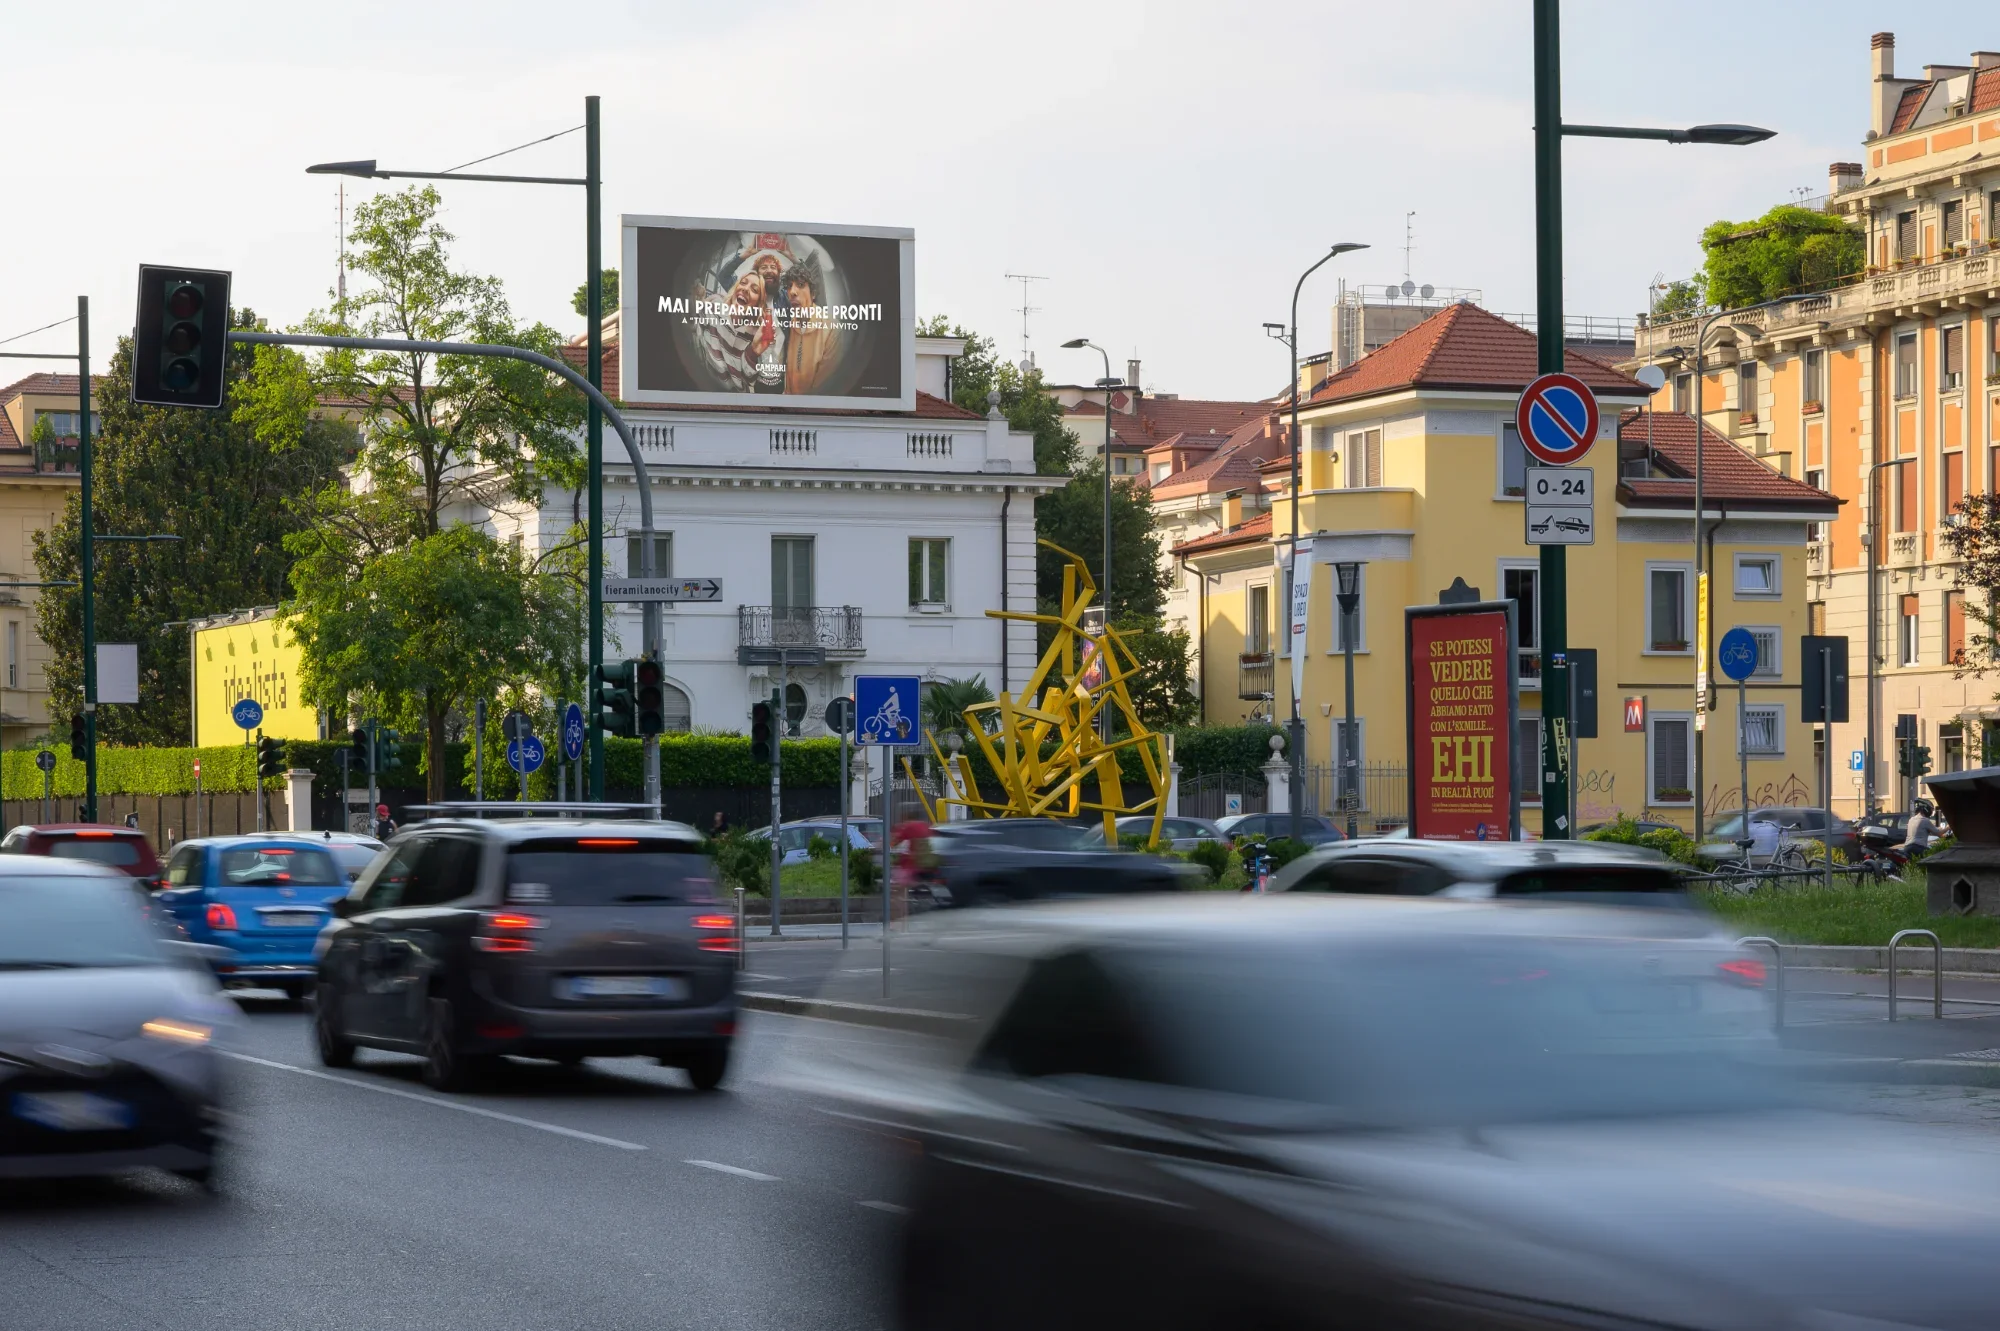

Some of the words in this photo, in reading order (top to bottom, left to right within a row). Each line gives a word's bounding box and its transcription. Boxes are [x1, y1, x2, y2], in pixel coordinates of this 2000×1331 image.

[658, 296, 689, 314] MAI
[695, 300, 763, 317] PREPARATI
[773, 307, 788, 318] MA
[790, 305, 829, 319] SEMPRE
[833, 303, 882, 321] PRONTI
[689, 317, 718, 325] "TUTTI
[720, 318, 731, 326] DA
[771, 320, 800, 328] ANCHE
[802, 321, 828, 330] SENZA
[830, 322, 859, 331] INVITO
[755, 363, 786, 372] CAMPARI
[605, 584, 679, 596] fieramilanocity
[1430, 641, 1444, 657] SE
[1446, 638, 1492, 656] POTESSI
[1430, 659, 1493, 683] VEDERE
[224, 659, 286, 714] idealista
[1430, 686, 1470, 704] QUELLO
[1472, 685, 1494, 700] CHE
[1430, 705, 1467, 717] ABBIAMO
[1468, 704, 1494, 716] FATTO
[1626, 705, 1642, 725] M
[1431, 721, 1446, 732] CON
[1431, 736, 1495, 783] EHI
[1853, 752, 1862, 769] P
[1431, 787, 1442, 798] IN
[1442, 785, 1471, 798] REALTÀ
[1473, 785, 1494, 798] PUOI!
